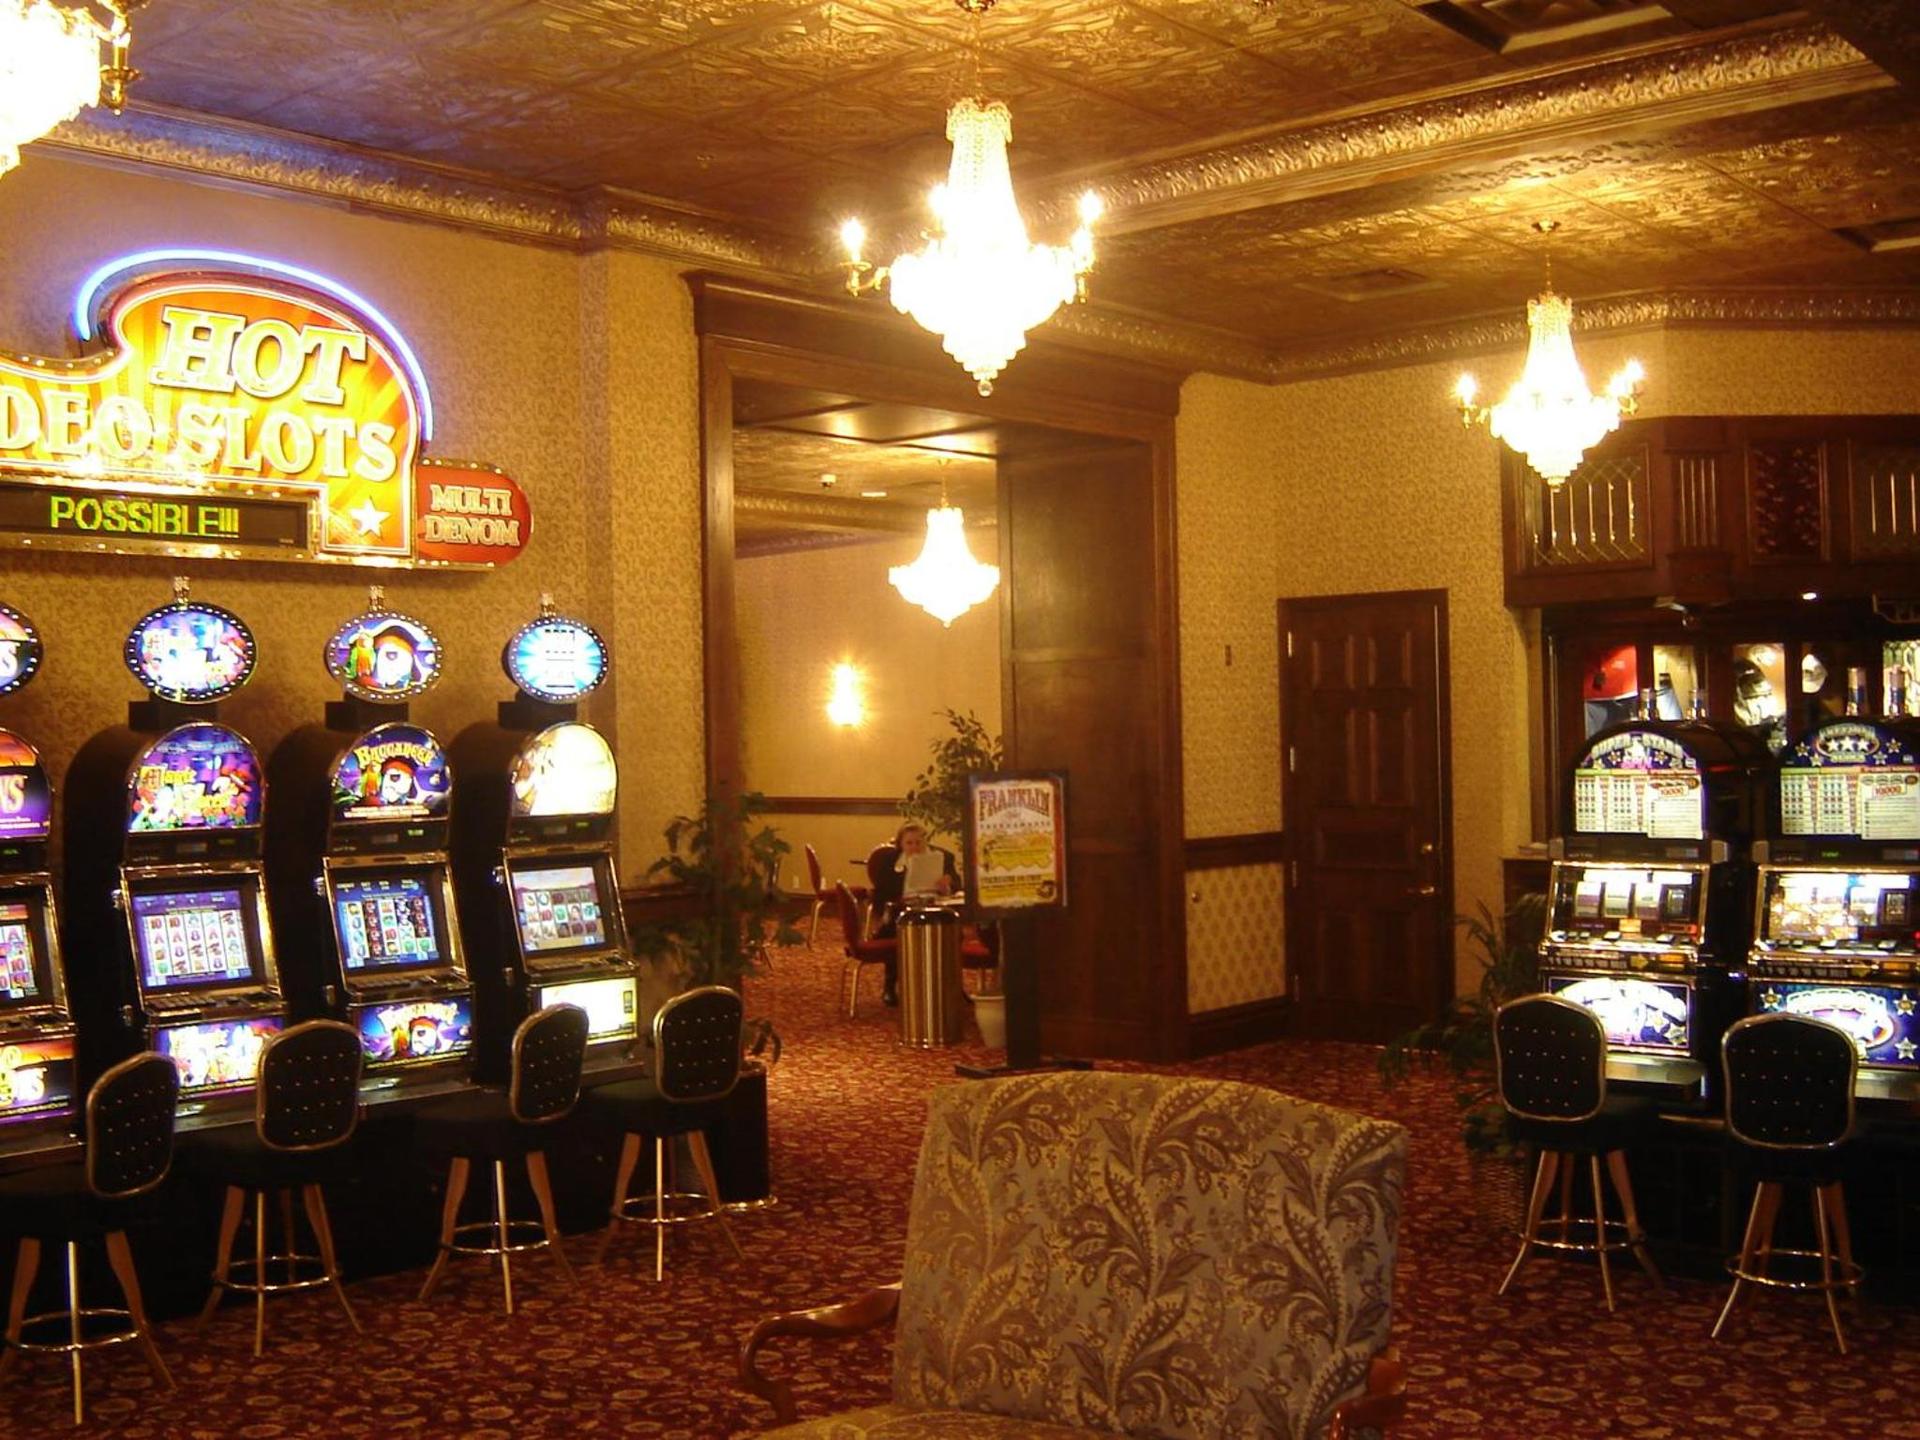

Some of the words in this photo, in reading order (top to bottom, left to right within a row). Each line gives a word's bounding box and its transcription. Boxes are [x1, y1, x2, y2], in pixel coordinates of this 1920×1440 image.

[150, 305, 367, 406] HOT
[177, 404, 398, 482] SLOTS
[51, 496, 239, 539] POSSIBLE!!!
[430, 484, 512, 516] MULTI
[424, 515, 520, 547] DENOM
